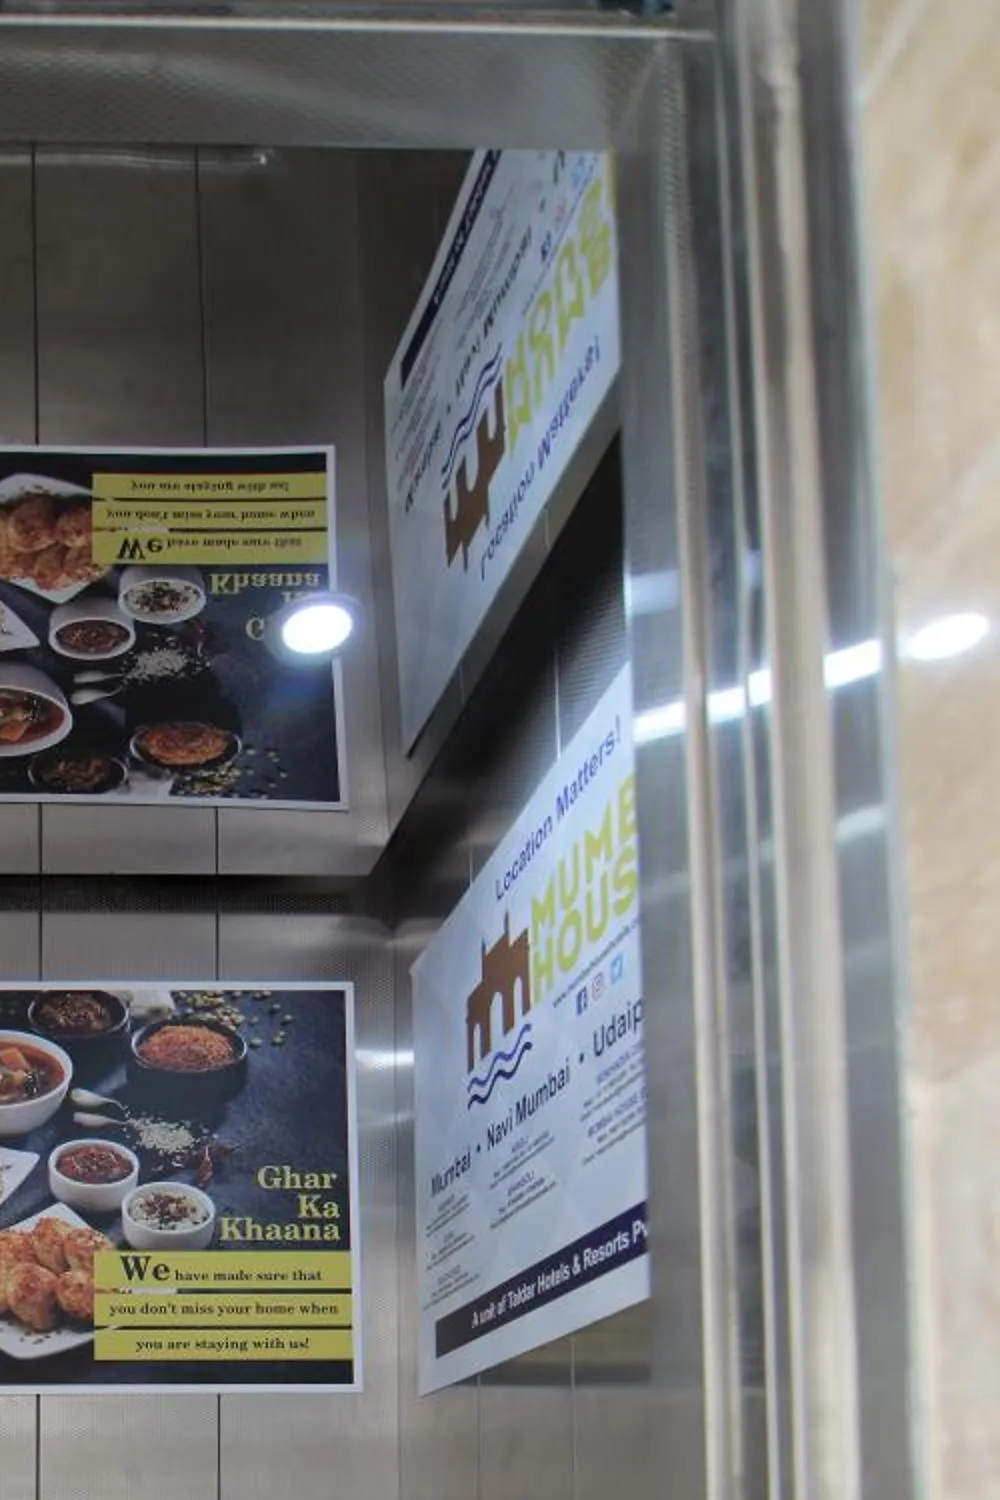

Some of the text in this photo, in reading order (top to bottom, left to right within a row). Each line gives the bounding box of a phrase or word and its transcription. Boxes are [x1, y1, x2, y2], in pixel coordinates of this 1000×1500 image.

[494, 714, 621, 901] Location Matters!
[487, 1106, 513, 1151] Navi
[515, 1057, 570, 1124] Mumbai
[257, 1165, 338, 1191] Ghar
[297, 1194, 341, 1219] Ka
[219, 1217, 341, 1242] Khaana
[583, 1231, 629, 1269] Resorts
[120, 1255, 323, 1282] We have made sure that
[109, 1301, 340, 1317] you don't miss your home when
[135, 1338, 311, 1352] you are staying with us!
